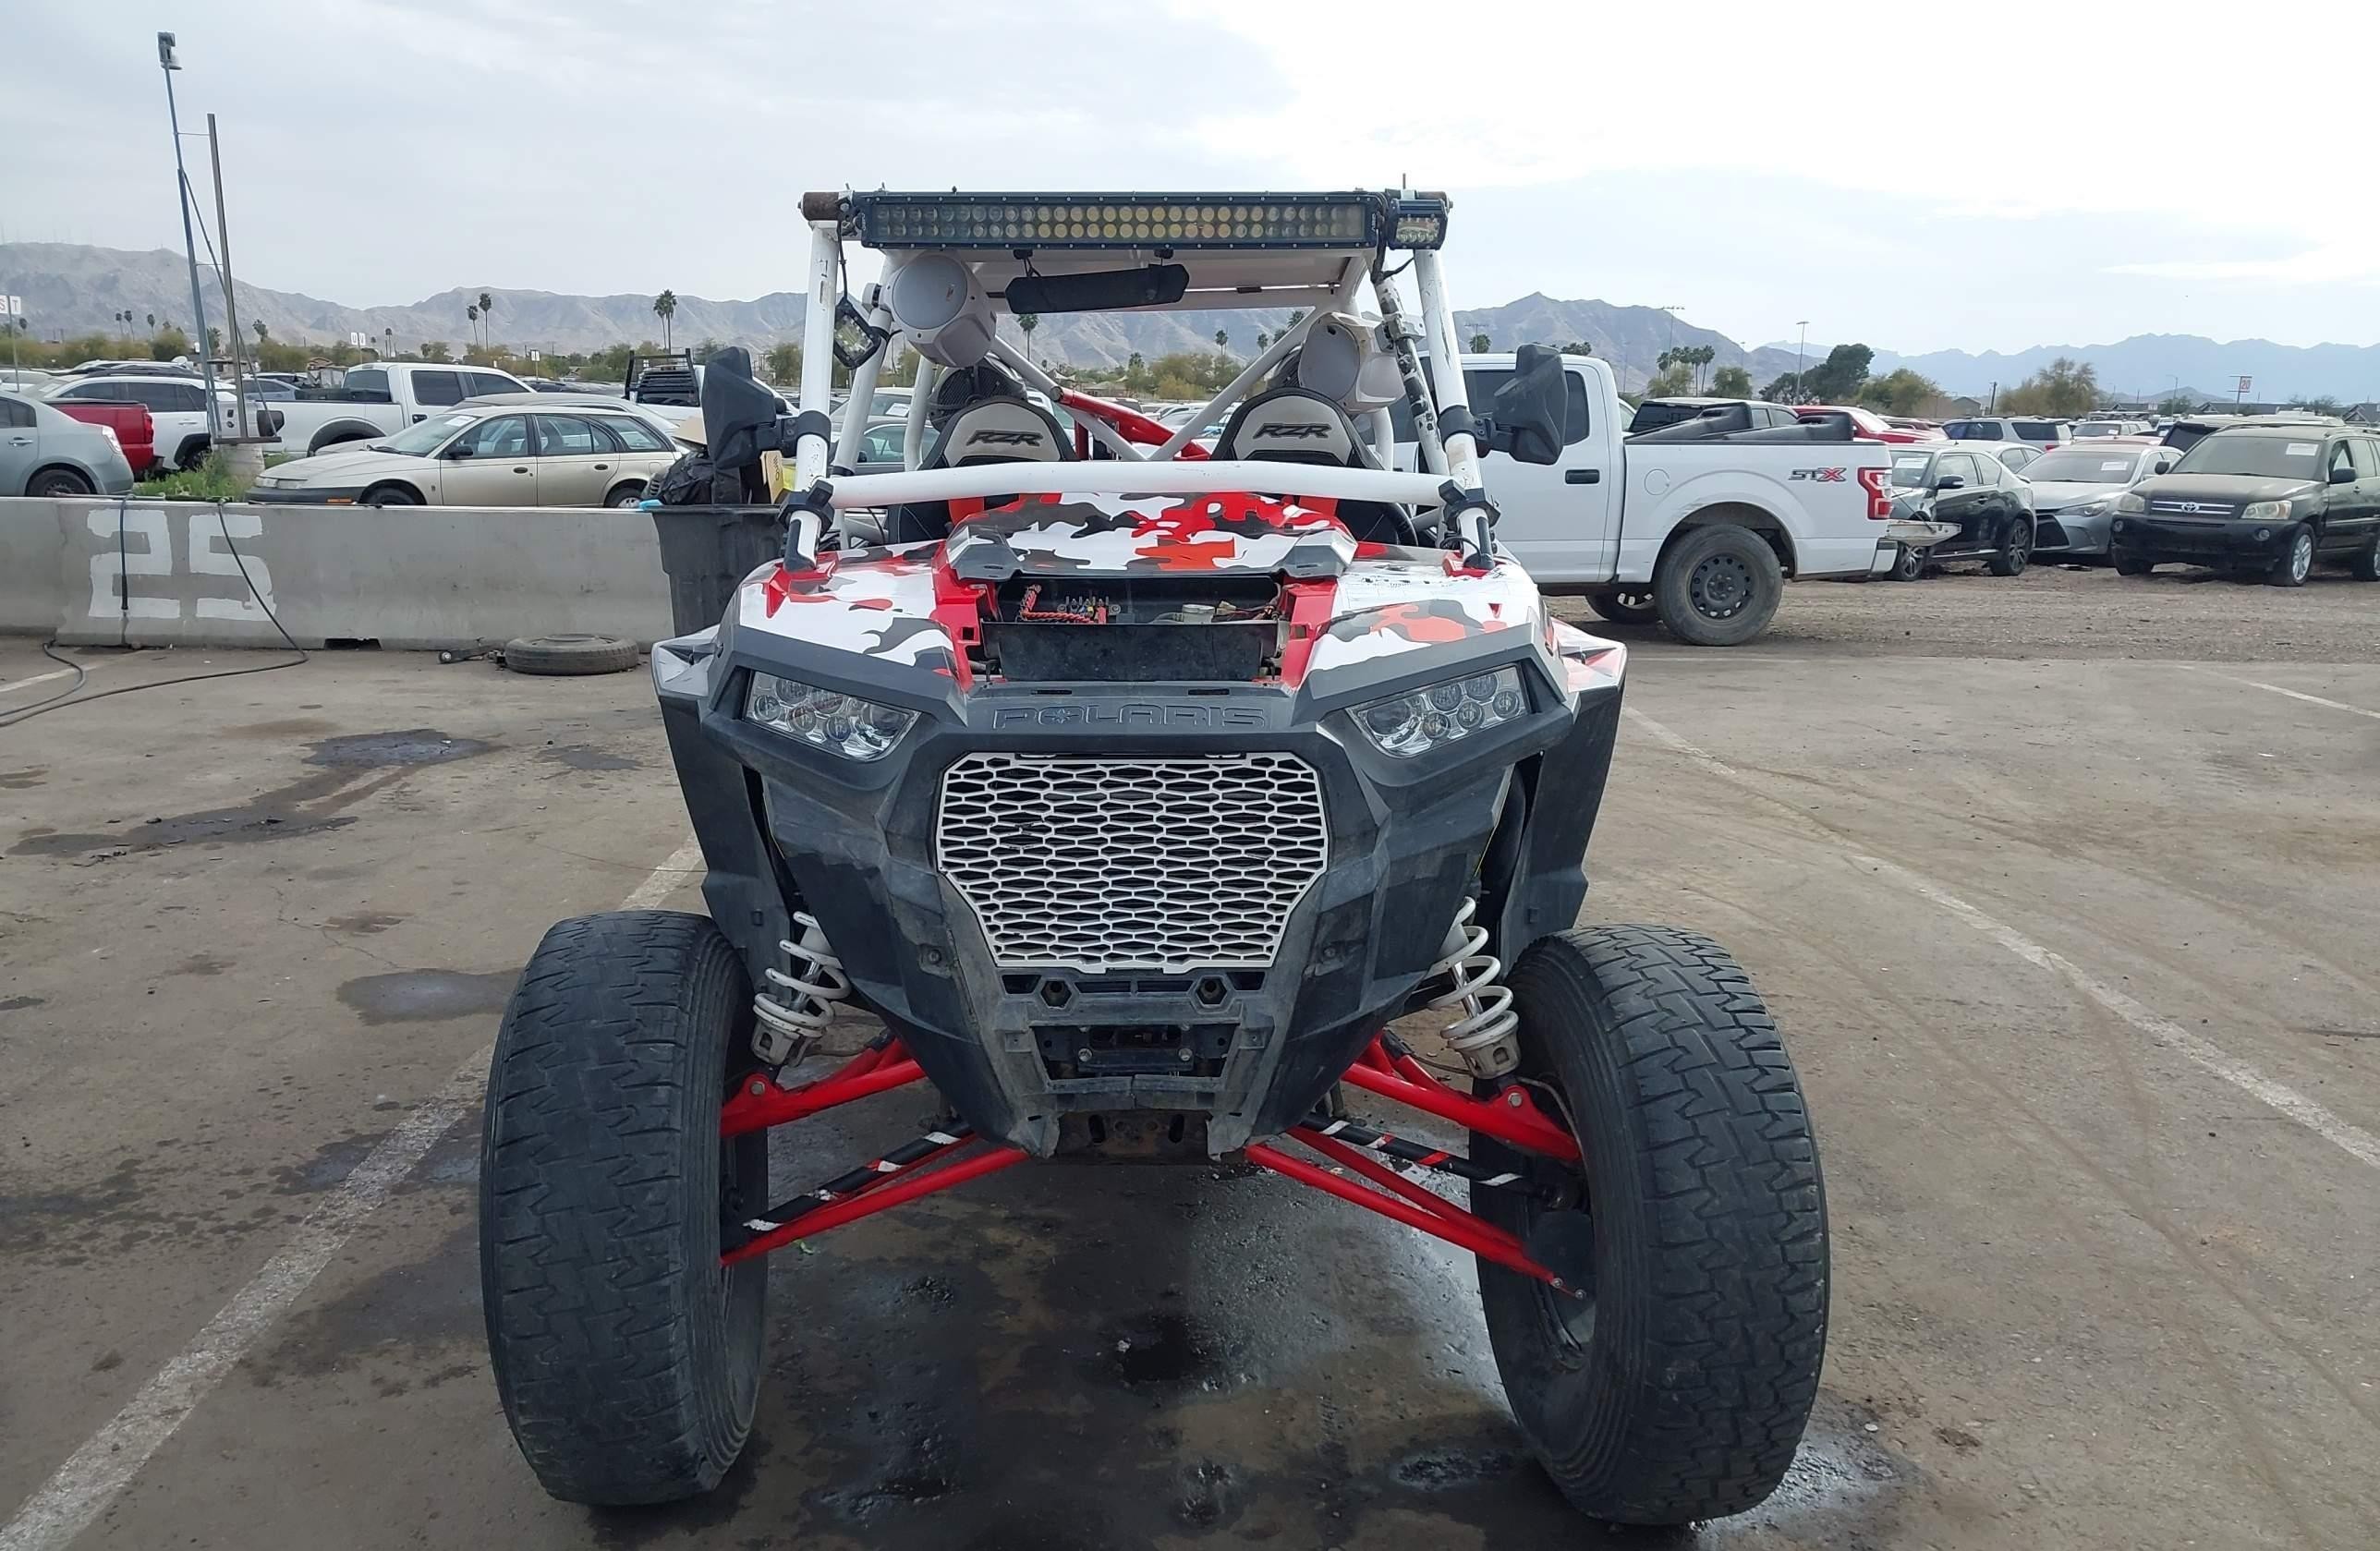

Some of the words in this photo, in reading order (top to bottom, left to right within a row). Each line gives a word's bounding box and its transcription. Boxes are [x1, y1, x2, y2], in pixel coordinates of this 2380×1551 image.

[965, 429, 1044, 447] RZR
[1253, 422, 1332, 440] RZR
[1788, 467, 1847, 482] STX
[87, 508, 277, 622] 25
[991, 703, 1266, 730] POLARIS
